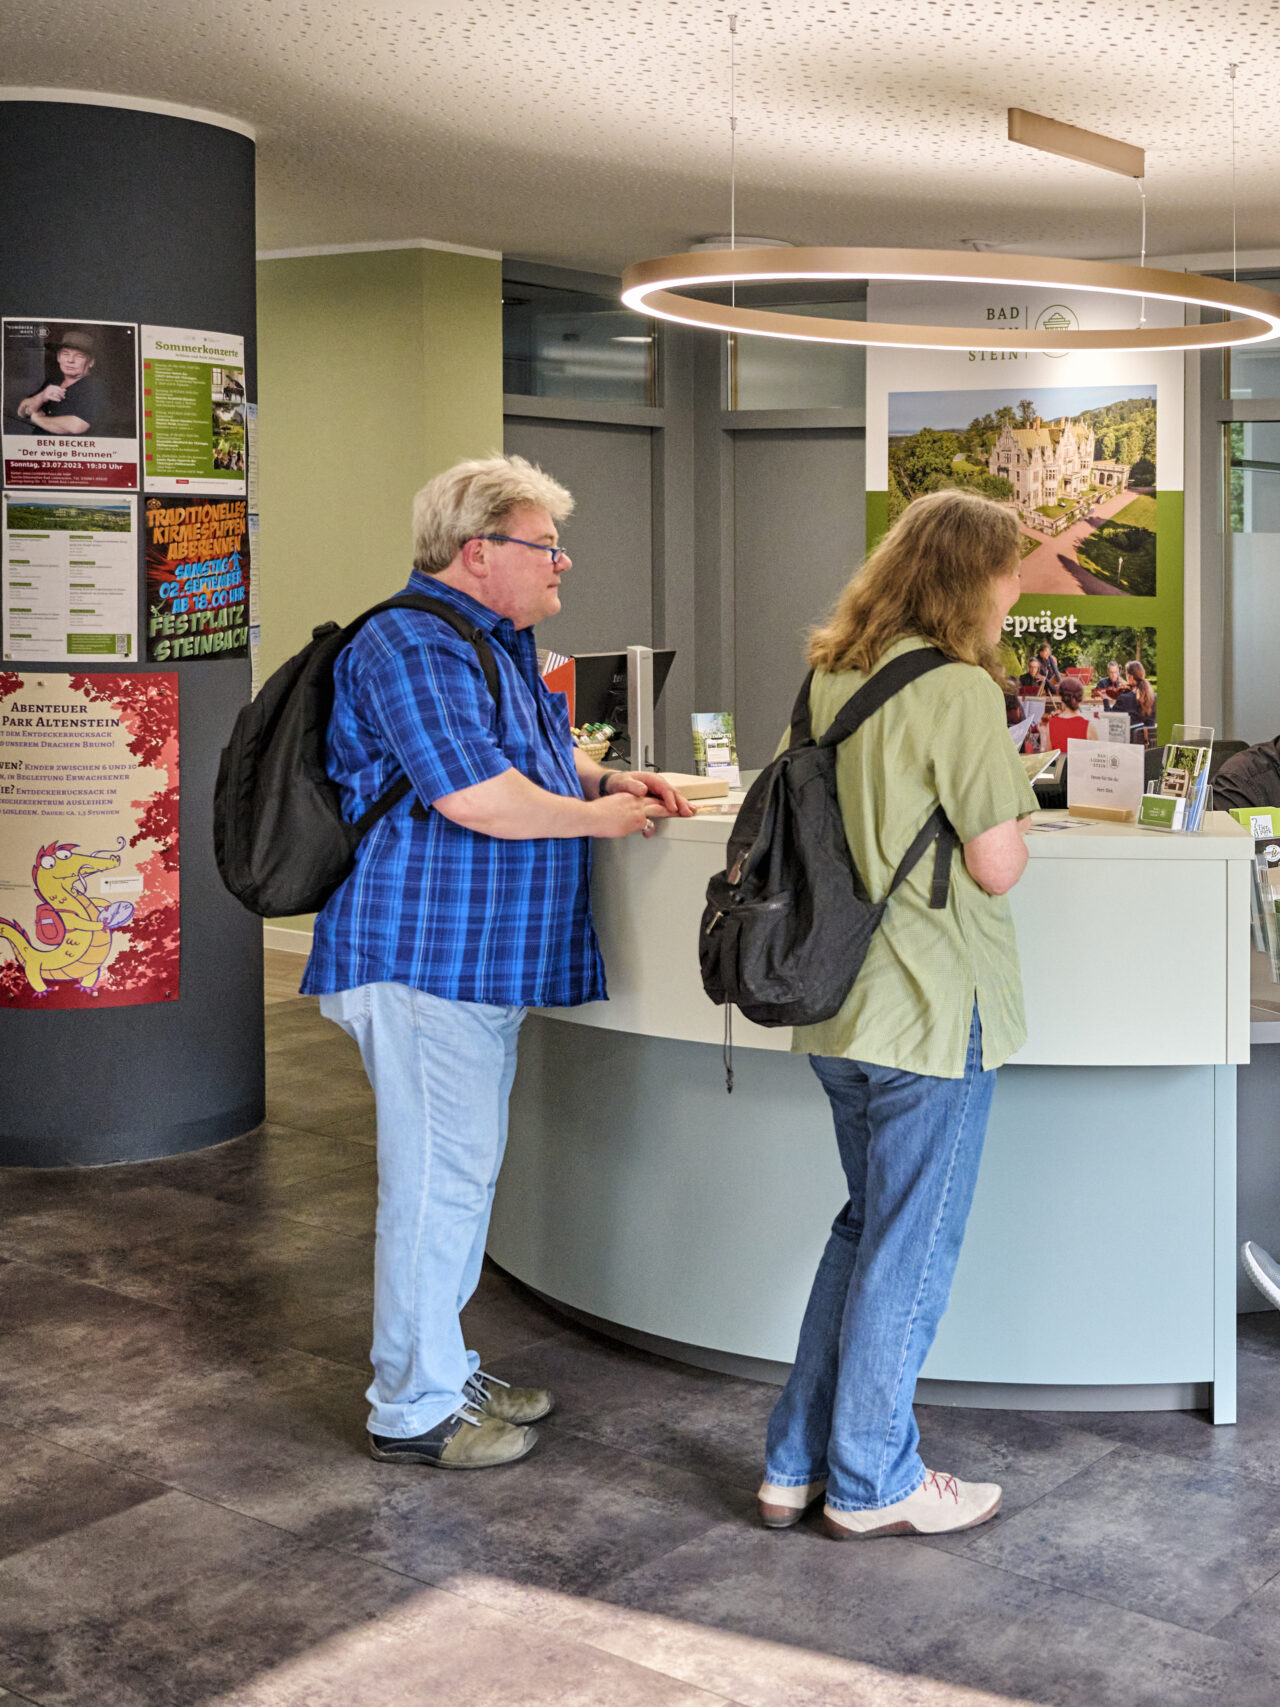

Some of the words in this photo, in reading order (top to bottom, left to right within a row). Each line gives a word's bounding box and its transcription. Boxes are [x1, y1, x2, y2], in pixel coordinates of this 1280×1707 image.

[986, 306, 1020, 320] BAD
[155, 340, 239, 358] Sommerkonzerte
[968, 350, 1018, 362] STEIN
[37, 439, 55, 447] BEN
[59, 440, 96, 448] BECKER
[41, 450, 68, 458] ewige
[10, 461, 40, 469] Sonntag,
[145, 501, 247, 527] TRADITIONELLES
[153, 518, 246, 544] KIRMESPUPPEN
[167, 535, 242, 560] ABBRENNEN
[174, 557, 229, 580] SAMSTAG
[172, 597, 190, 614] AB
[193, 590, 228, 610] 18.00
[229, 586, 246, 603] UHR
[150, 604, 245, 638] FESTPLATZ
[1002, 610, 1078, 640] eprägt
[154, 626, 249, 662] STEINBACH
[0, 784, 15, 794] IE?
